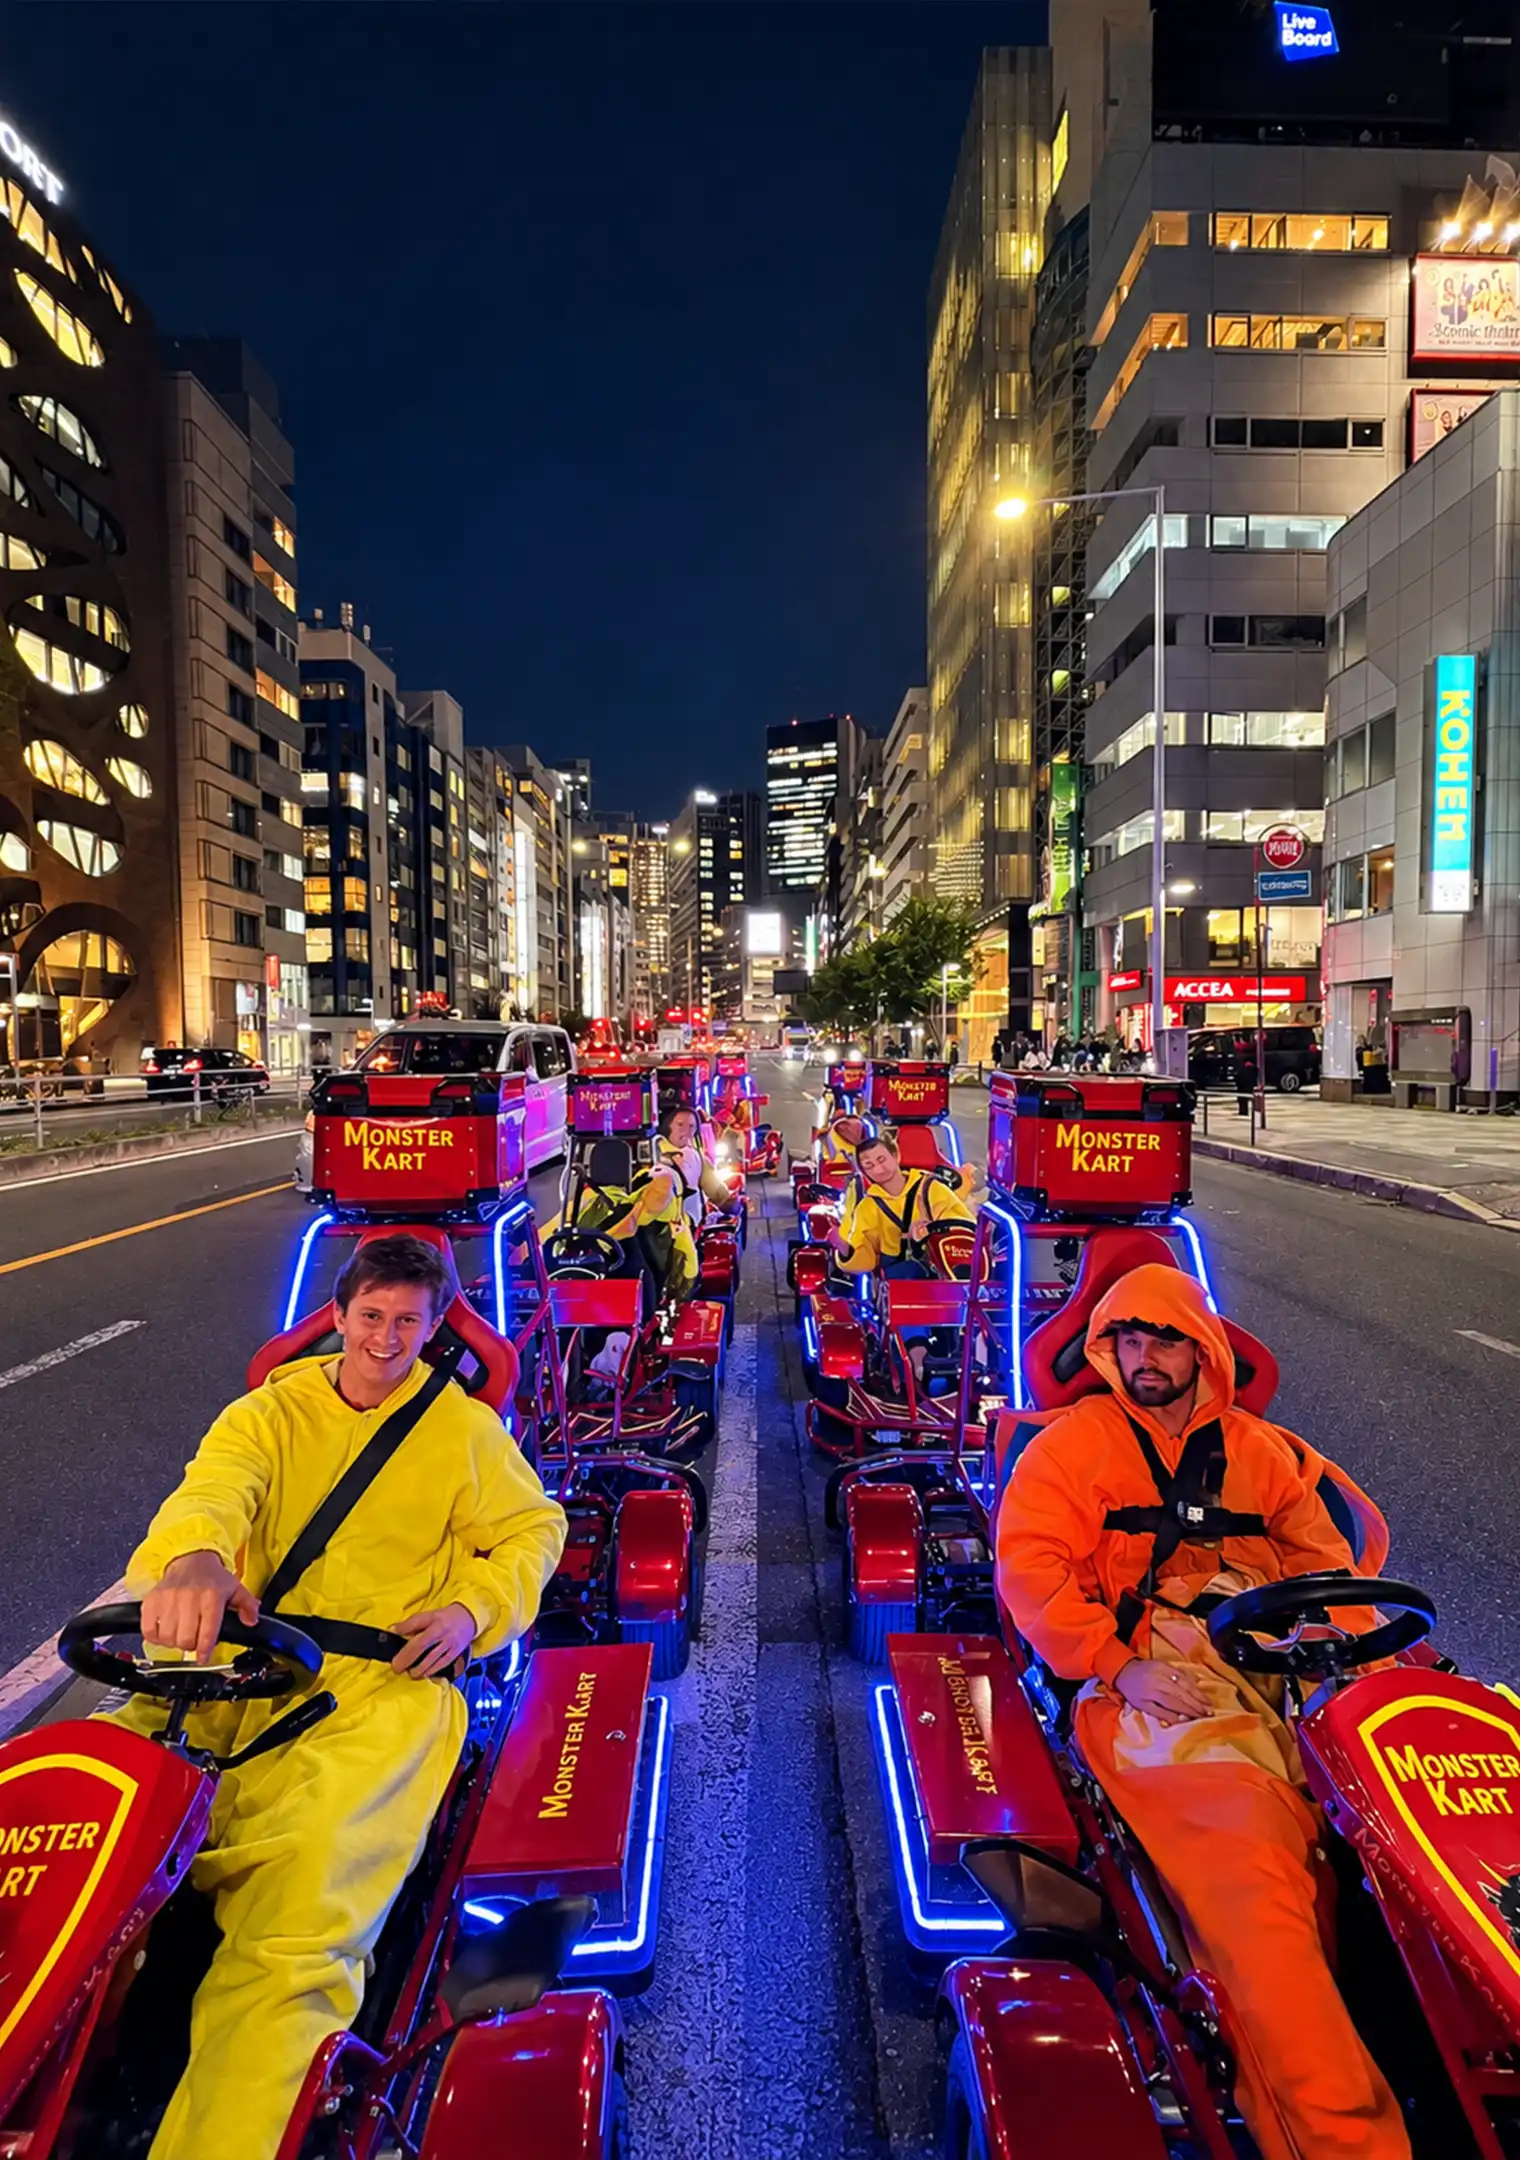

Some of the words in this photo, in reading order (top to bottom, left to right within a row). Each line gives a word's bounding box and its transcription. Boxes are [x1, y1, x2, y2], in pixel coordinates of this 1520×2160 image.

[1282, 12, 1316, 30] Live
[1282, 29, 1332, 47] Board
[1174, 981, 1234, 998] ACCEA
[343, 1121, 454, 1147] MONSTER
[1055, 1123, 1161, 1150] MONSTER
[362, 1147, 427, 1171] KART
[1071, 1148, 1134, 1173] KART
[1424, 1780, 1514, 1816] KART
